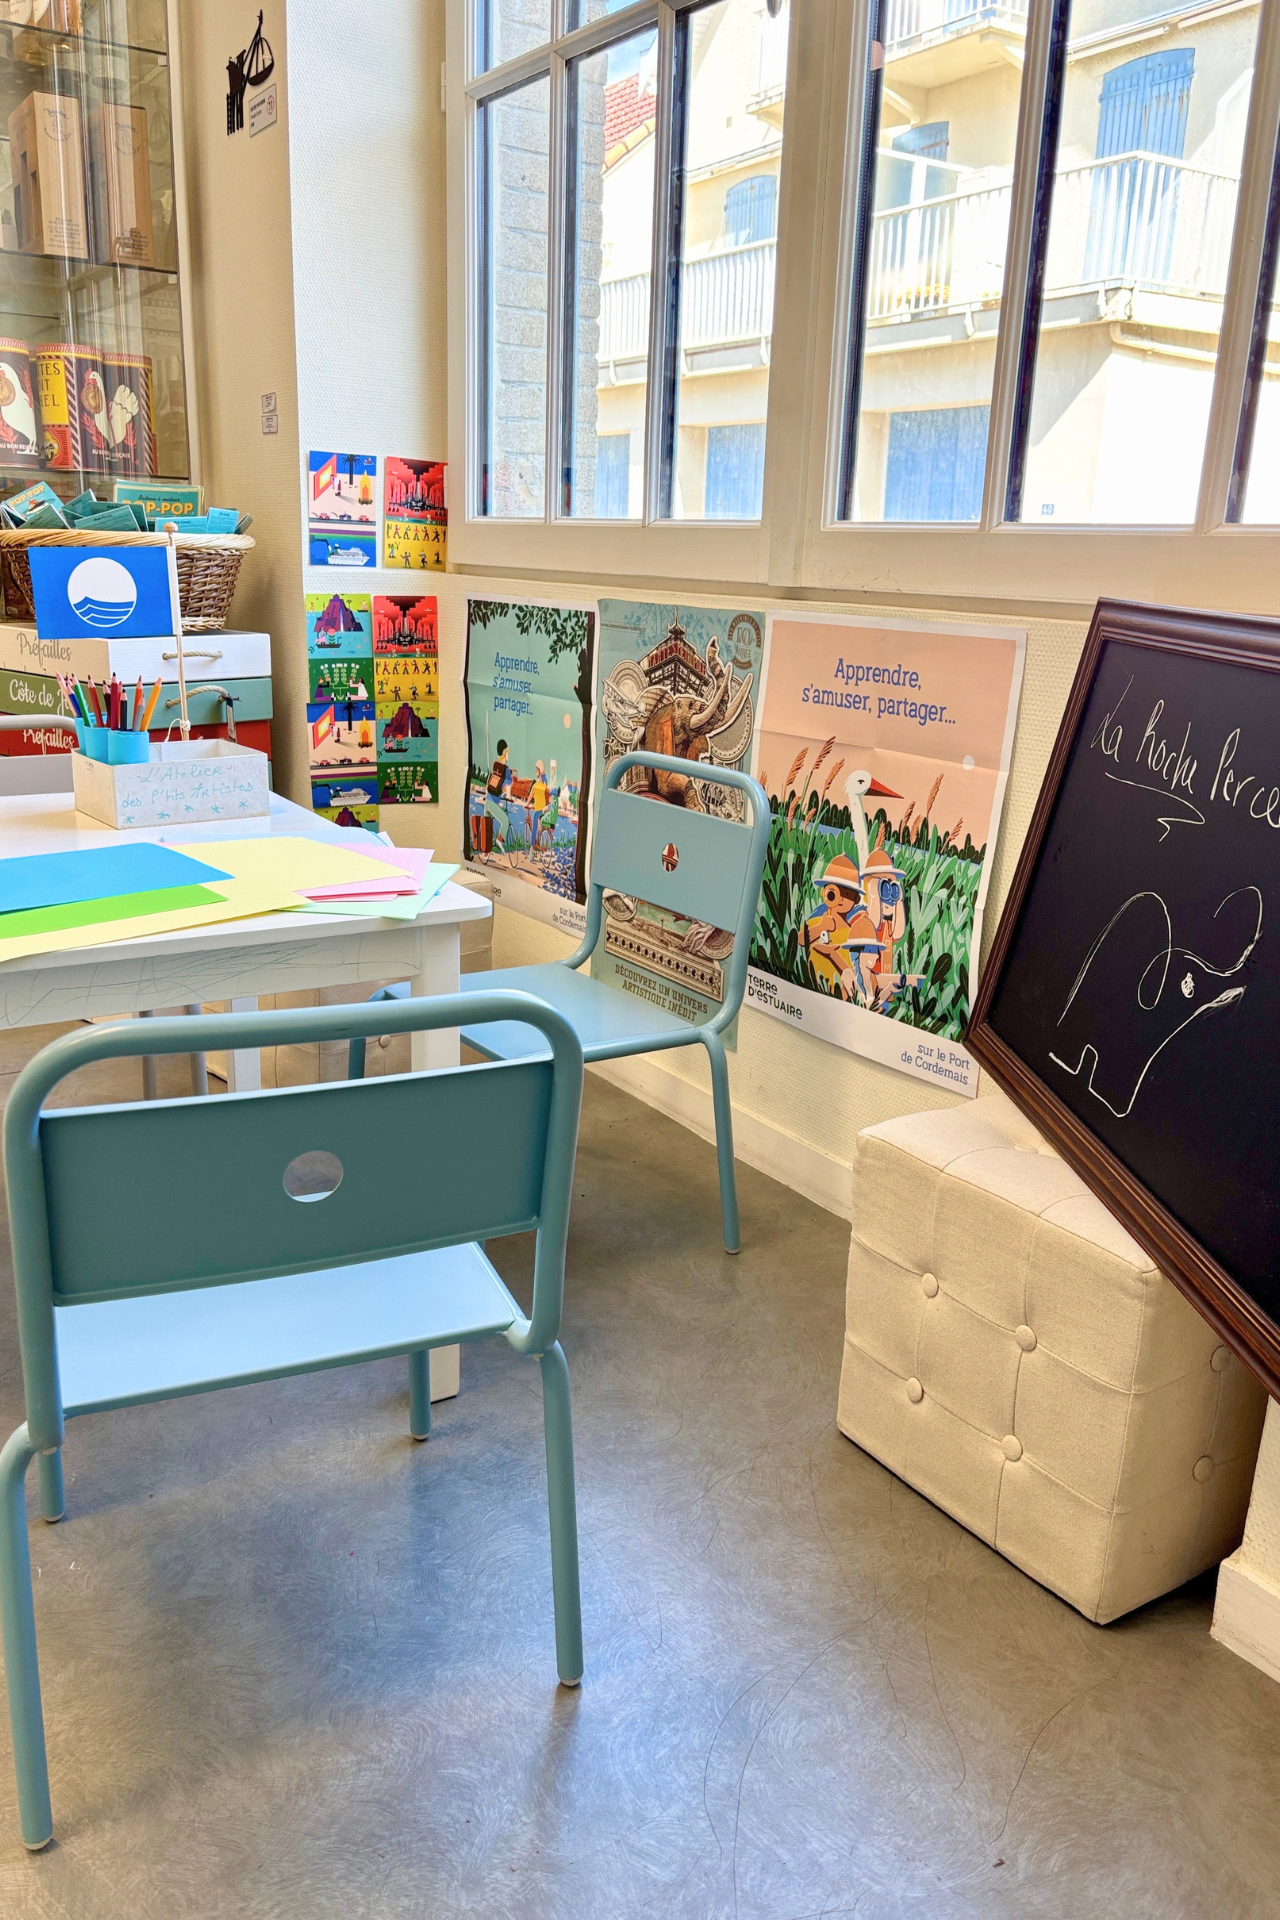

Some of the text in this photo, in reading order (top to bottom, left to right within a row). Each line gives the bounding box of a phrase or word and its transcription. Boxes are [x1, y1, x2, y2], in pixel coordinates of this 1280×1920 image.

[122, 499, 194, 515] P-POP
[494, 652, 540, 676] Apprendre,
[834, 658, 922, 691] Apprendre,
[9, 679, 36, 704] Côte
[38, 683, 54, 707] de
[493, 673, 534, 695] s'amuser,
[494, 696, 534, 717] partager...
[802, 683, 956, 726] s'amuser, partager...
[122, 793, 142, 808] des
[552, 913, 559, 922] de
[560, 907, 568, 916] sur
[569, 909, 575, 918] le
[615, 963, 708, 1014] DÉCOUVREZ UN UNIVERS
[622, 979, 697, 1022] ARTISTIQUE INÉDIT
[901, 1050, 969, 1085] de Cordemais
[917, 1044, 970, 1070] sur le Port
